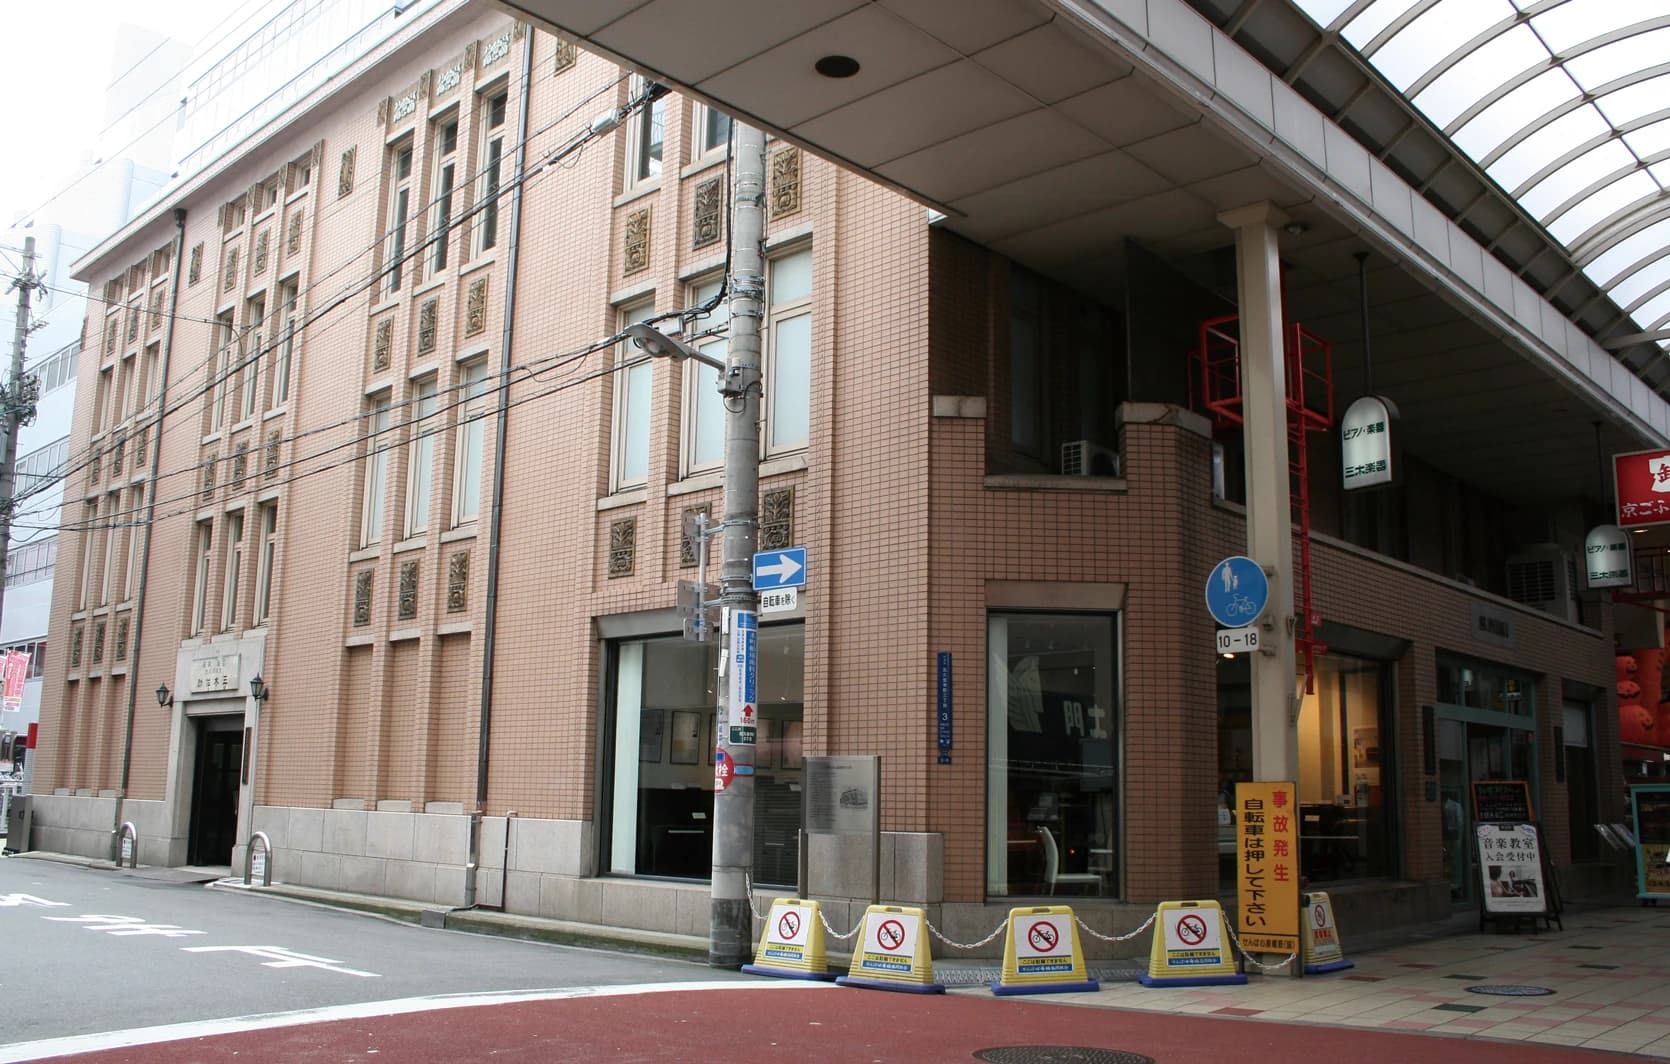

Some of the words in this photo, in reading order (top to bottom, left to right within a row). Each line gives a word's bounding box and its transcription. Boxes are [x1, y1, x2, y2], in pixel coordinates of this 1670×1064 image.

[1343, 421, 1384, 440] ピアノ・楽器
[1345, 460, 1386, 478] 三木楽器
[763, 593, 795, 608] 自転車を除く
[942, 712, 948, 721] 3
[1272, 790, 1289, 882] 事故発生
[1484, 837, 1534, 849] 音楽教室
[1244, 799, 1267, 927] 自転車は押して下さい
[1485, 851, 1536, 862] 入会受付中
